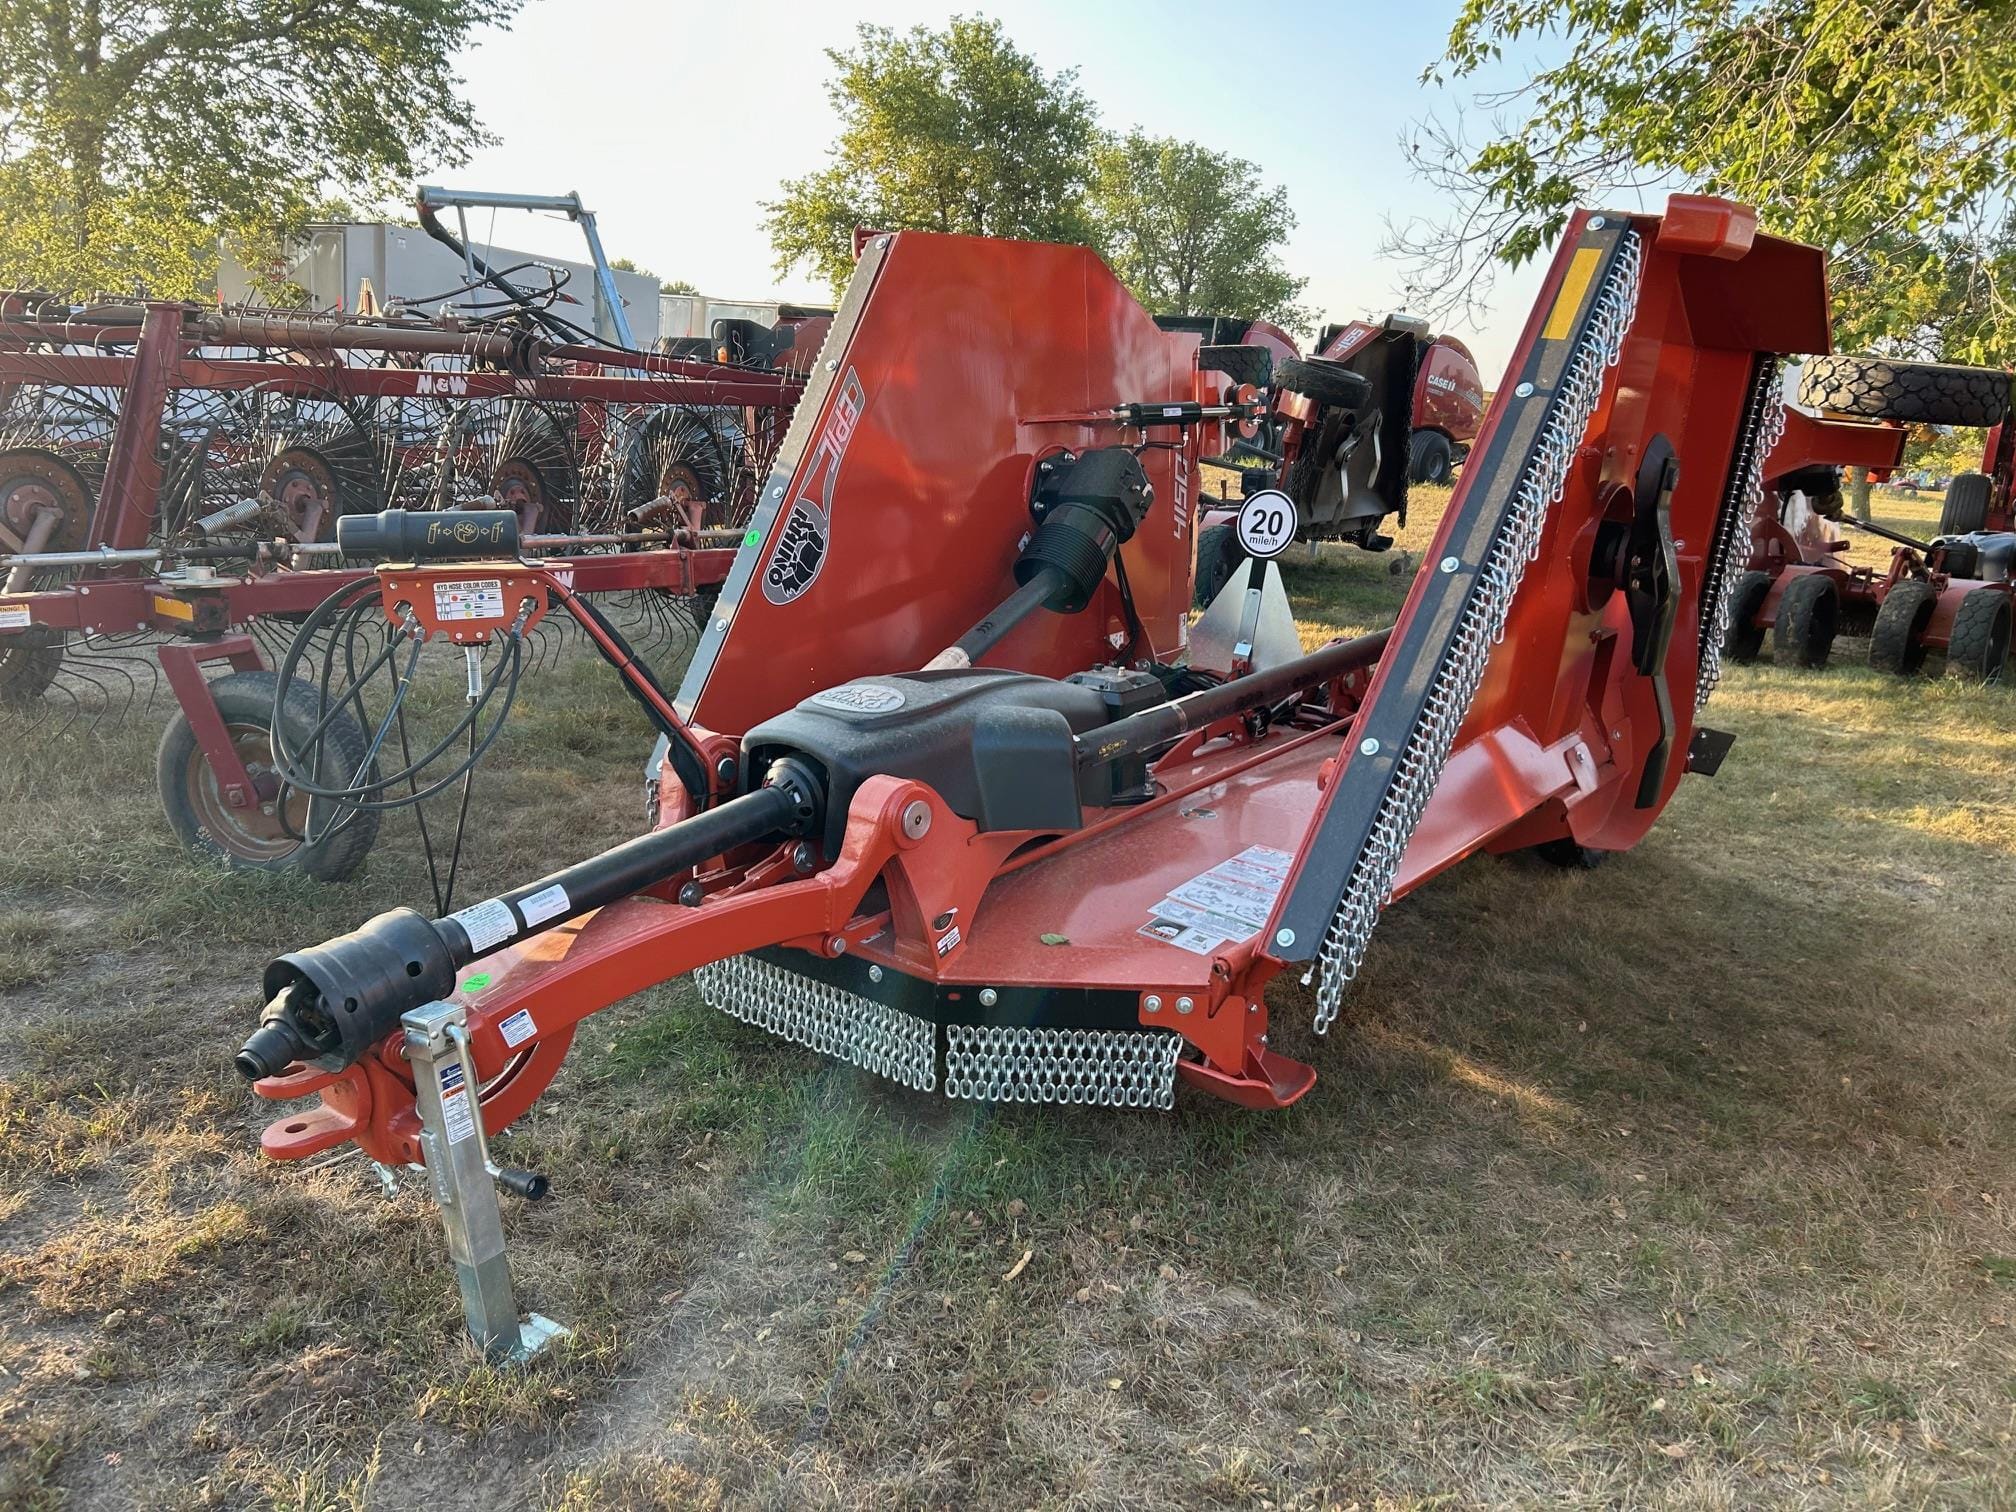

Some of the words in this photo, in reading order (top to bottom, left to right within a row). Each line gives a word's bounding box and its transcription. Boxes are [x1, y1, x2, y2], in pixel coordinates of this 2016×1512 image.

[1333, 327, 1366, 352] 4155
[416, 374, 469, 395] M&W
[1427, 374, 1448, 389] CASE
[817, 391, 858, 473] EPIC
[1173, 452, 1188, 540] 4150
[1249, 509, 1283, 536] 20
[768, 506, 815, 587] RHINO
[1249, 535, 1278, 546] mile/h
